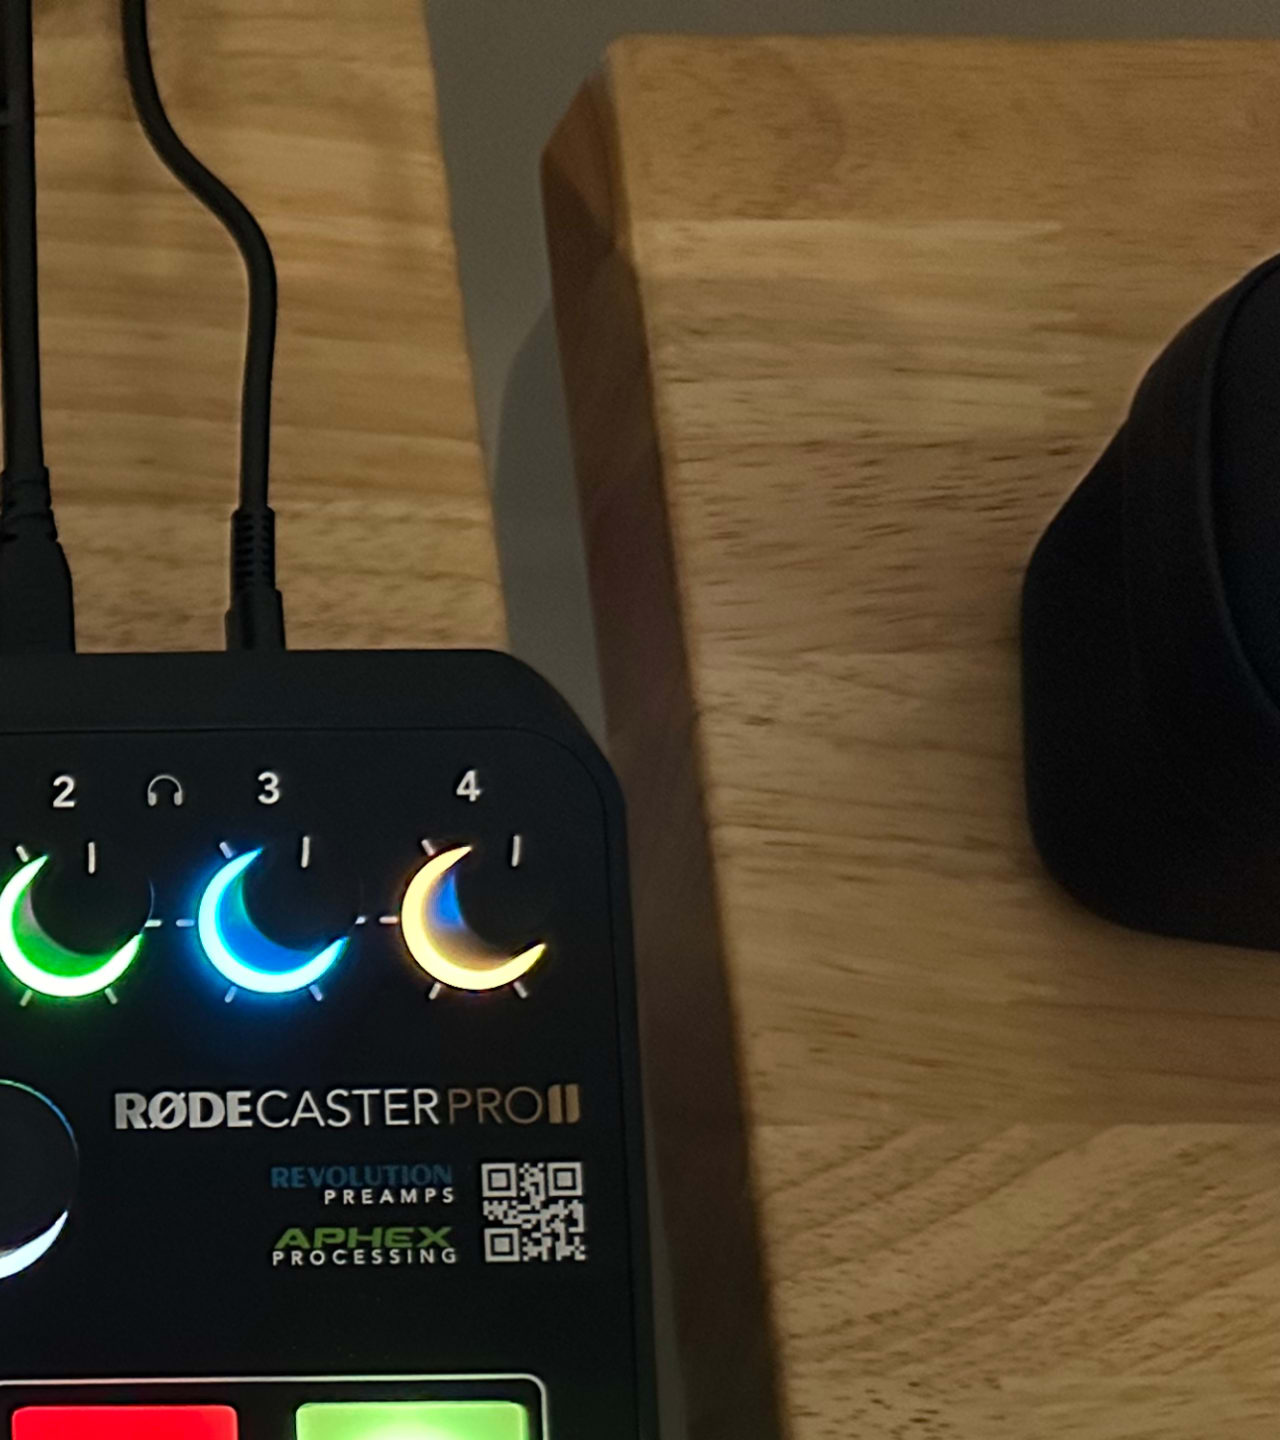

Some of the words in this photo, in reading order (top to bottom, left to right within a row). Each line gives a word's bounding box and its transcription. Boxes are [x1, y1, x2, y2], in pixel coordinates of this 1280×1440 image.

[53, 776, 77, 808] 2
[257, 772, 281, 805] 3
[455, 769, 481, 801] 4
[270, 1164, 453, 1189] REVOLUTION
[324, 1187, 456, 1206] PREAMPS
[273, 1226, 454, 1249] APHEX
[271, 1247, 458, 1267] PROCESSING
